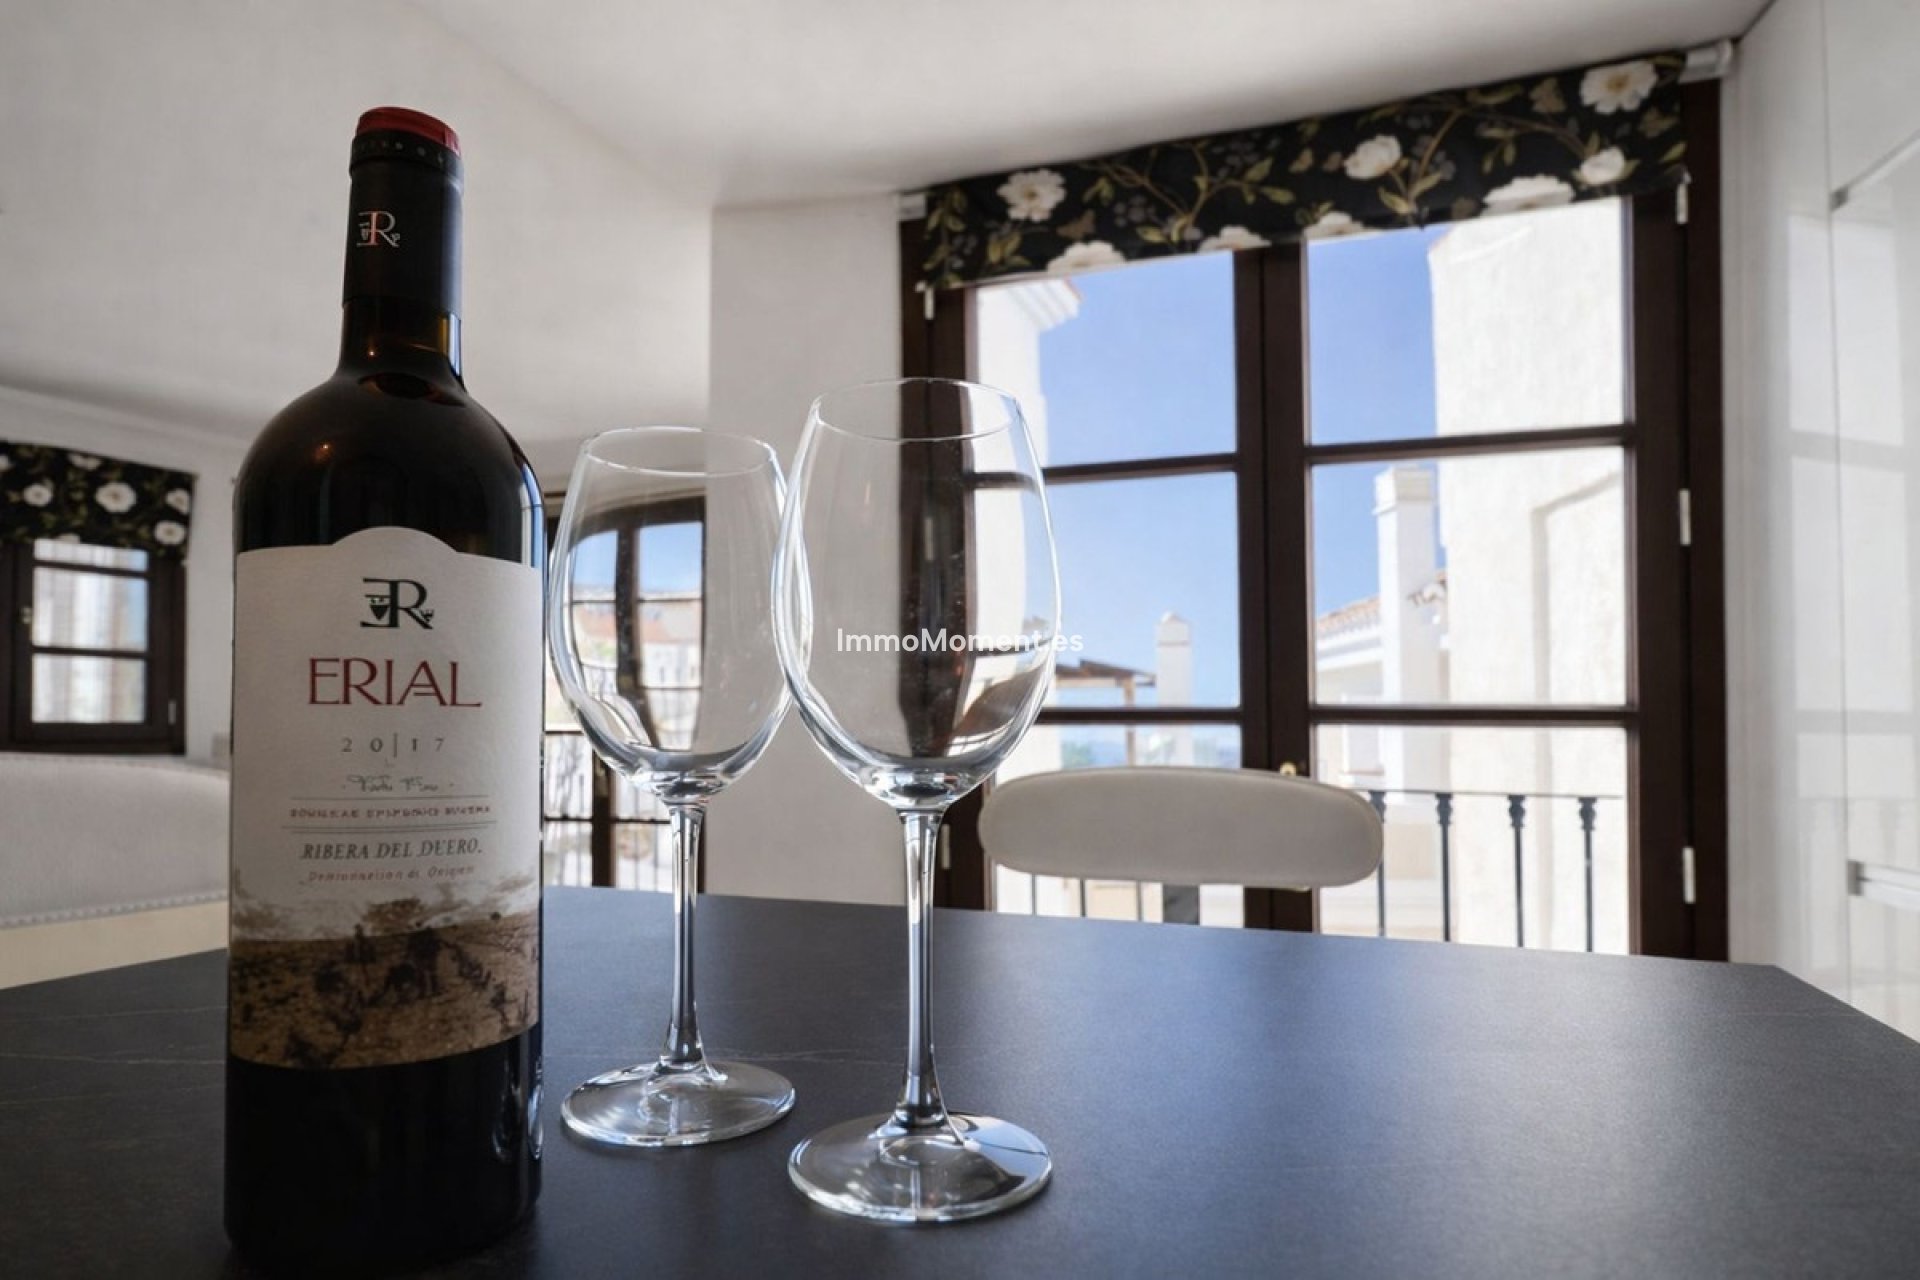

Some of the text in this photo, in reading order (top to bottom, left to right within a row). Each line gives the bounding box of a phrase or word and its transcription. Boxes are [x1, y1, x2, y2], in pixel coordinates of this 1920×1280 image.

[308, 657, 482, 708] ERIAL
[300, 842, 369, 861] RIBERA
[375, 841, 413, 860] DEL
